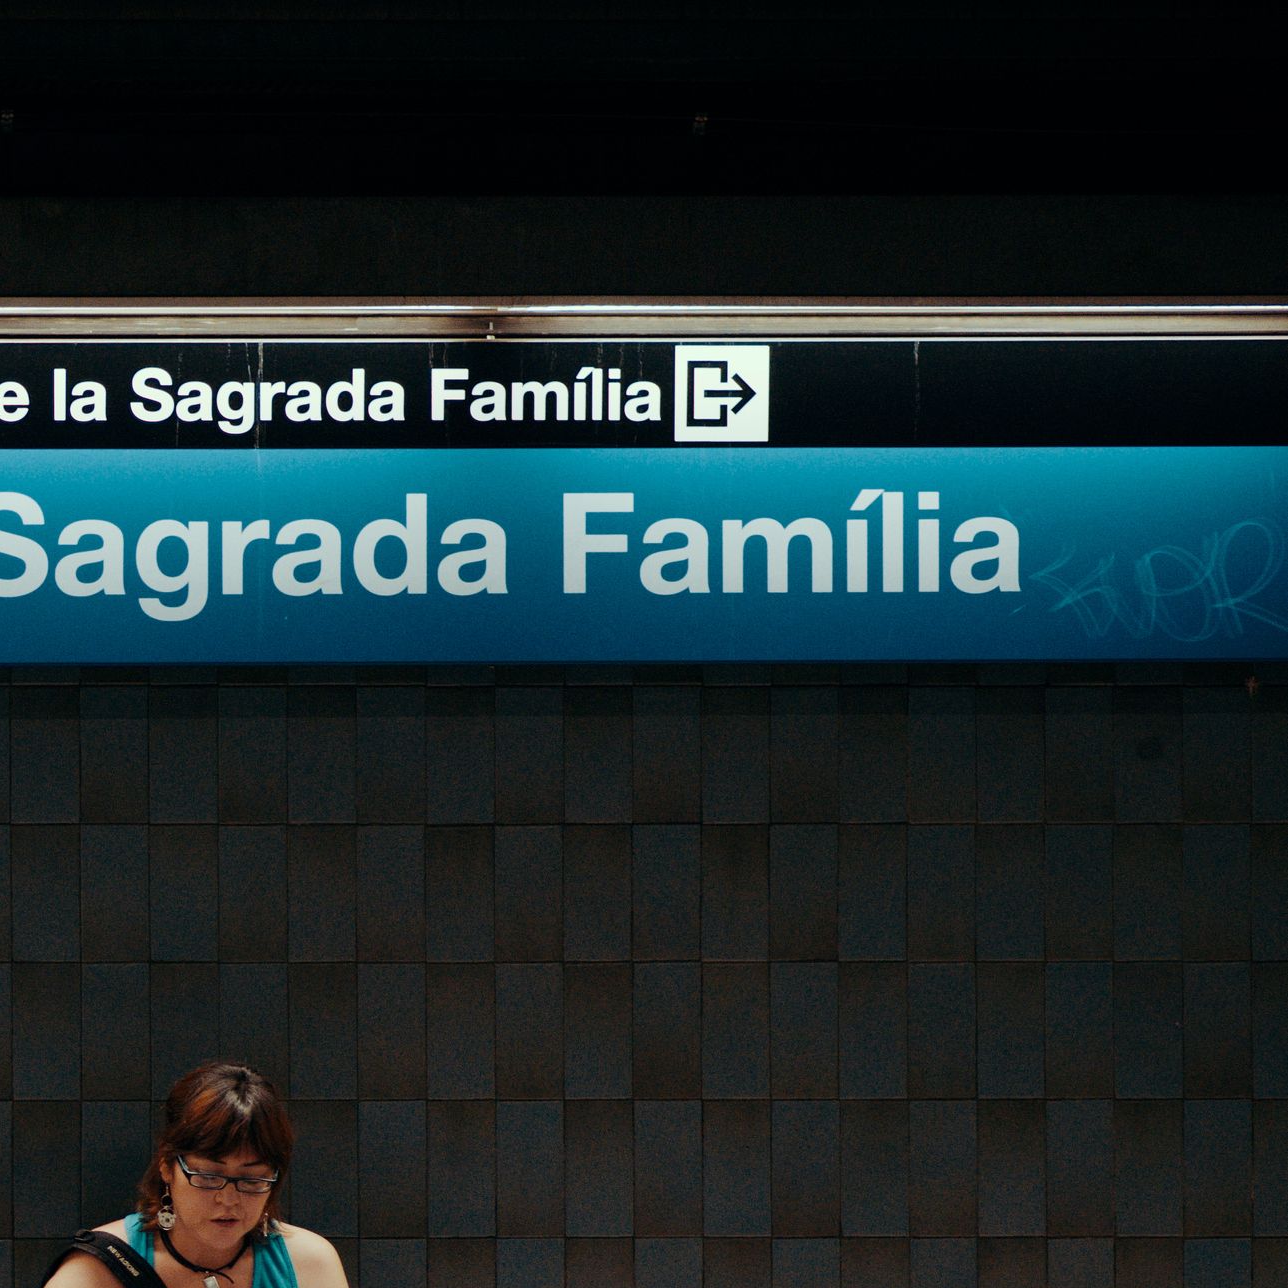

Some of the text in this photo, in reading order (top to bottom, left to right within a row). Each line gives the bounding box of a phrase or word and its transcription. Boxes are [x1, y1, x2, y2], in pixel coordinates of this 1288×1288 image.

[54, 369, 108, 421] la
[130, 367, 405, 434] Sagrada
[431, 367, 662, 421] Família
[563, 489, 1021, 595] Família
